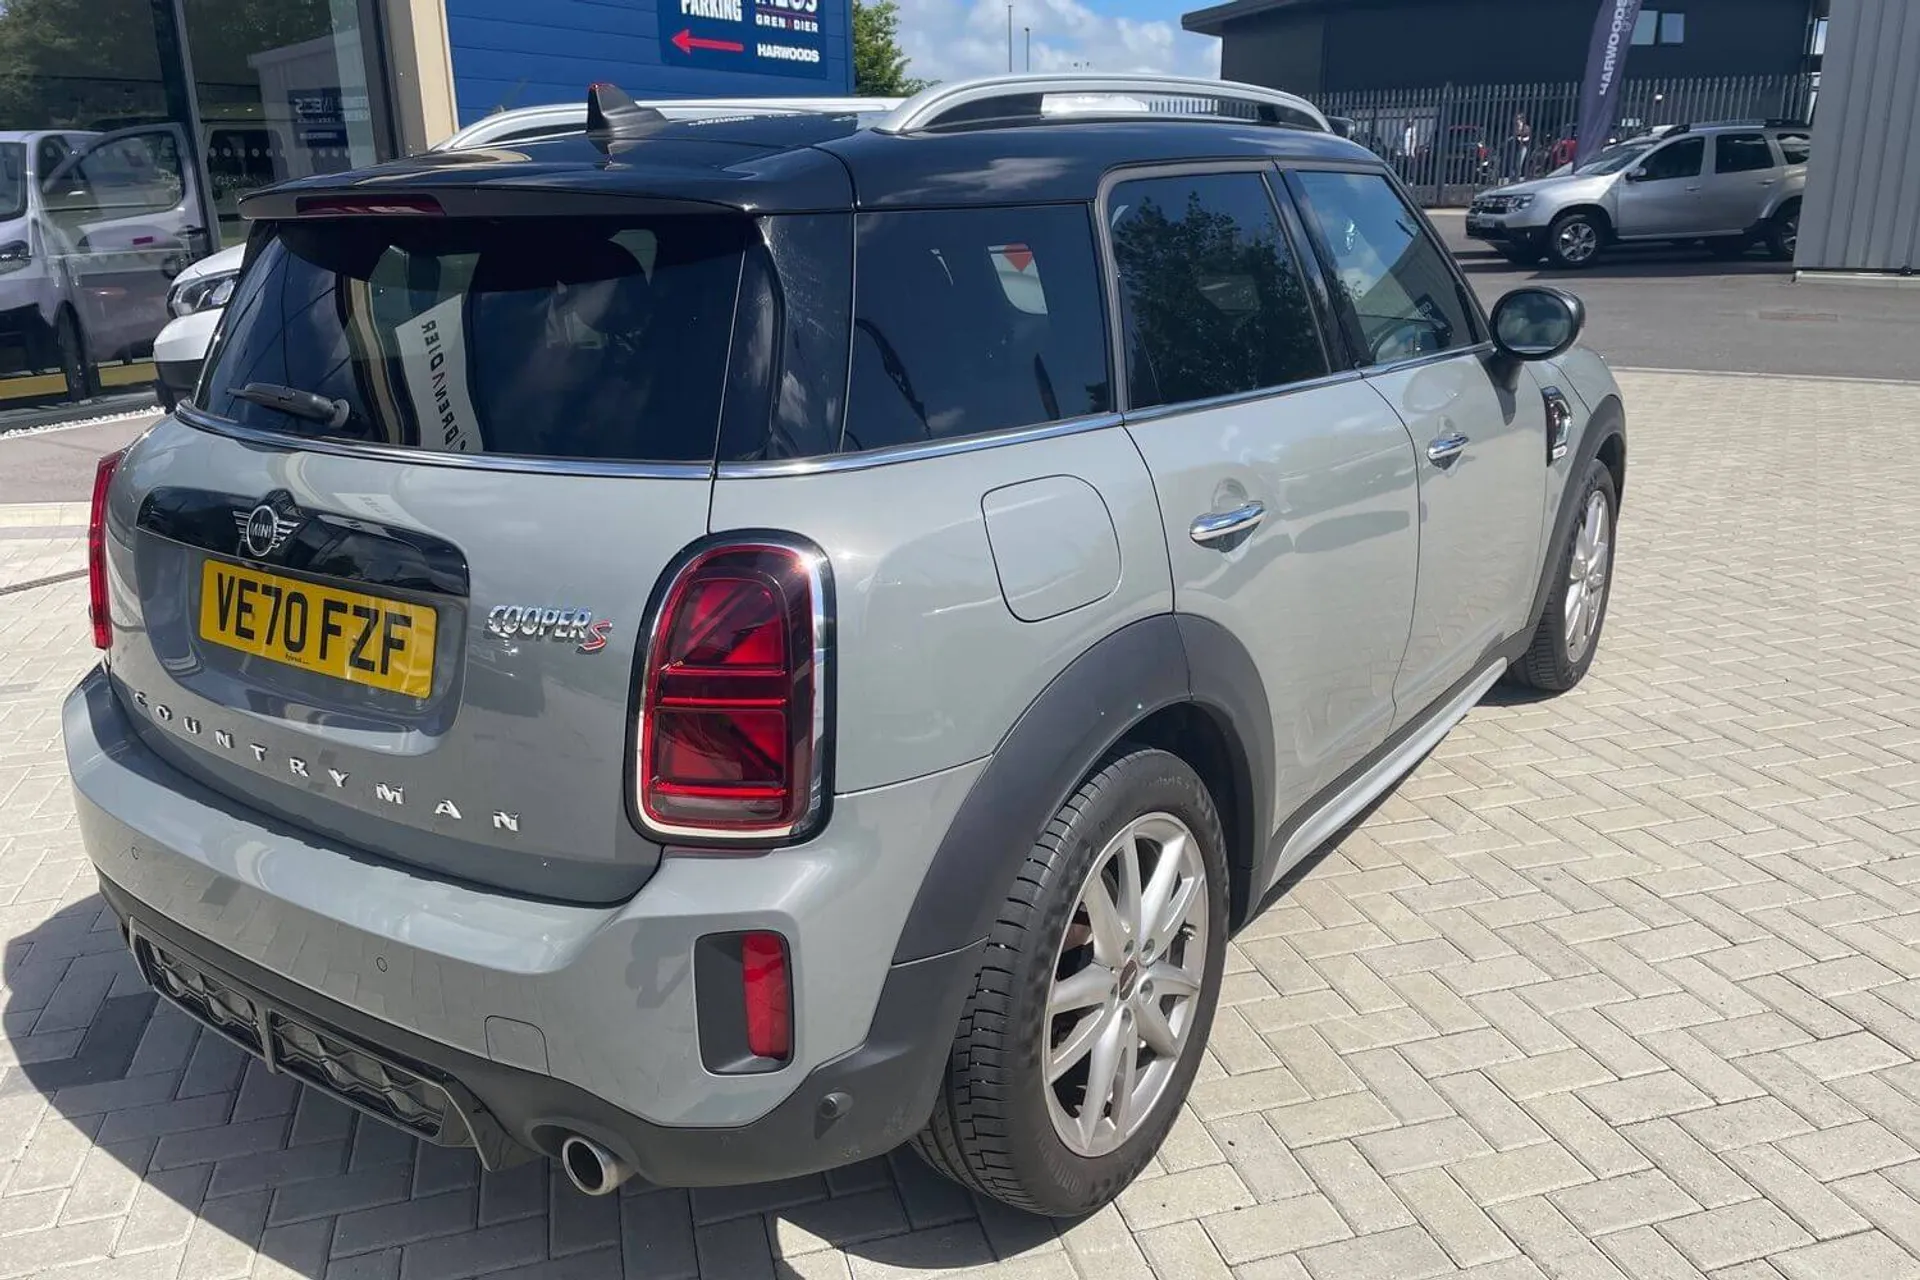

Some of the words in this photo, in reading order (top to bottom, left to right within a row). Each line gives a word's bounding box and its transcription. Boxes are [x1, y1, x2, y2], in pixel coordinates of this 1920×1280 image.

[681, 0, 742, 21] PARKING
[755, 13, 819, 33] GRENADIER
[757, 43, 820, 63] HARWOODS
[249, 522, 273, 539] MINI
[217, 572, 308, 653] VE70
[319, 598, 412, 675] FZF
[134, 691, 520, 832] COUNTRYMAN
